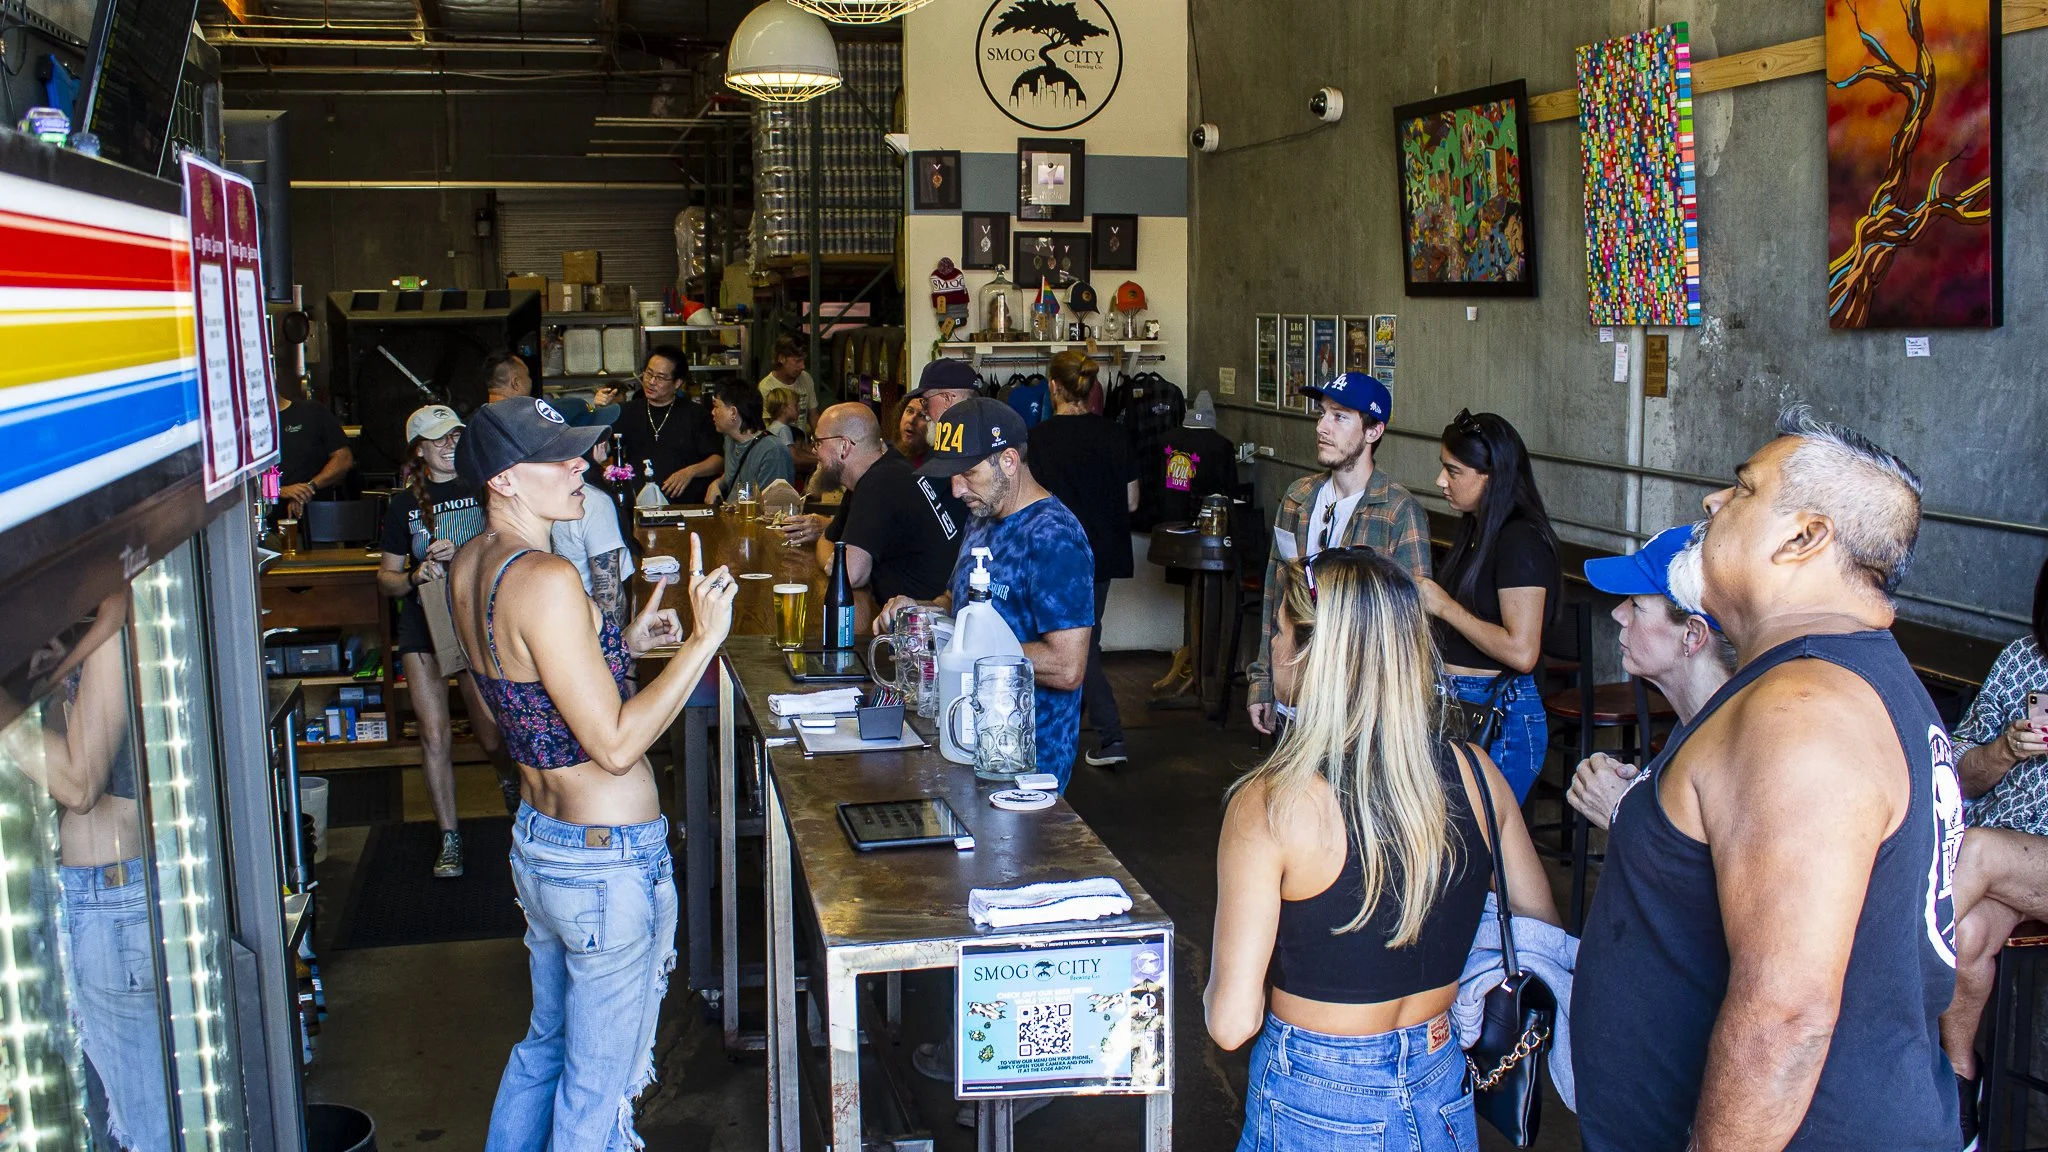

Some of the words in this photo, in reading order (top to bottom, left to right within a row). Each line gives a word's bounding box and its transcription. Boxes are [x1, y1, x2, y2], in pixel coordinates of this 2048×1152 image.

[987, 47, 1035, 62] SMOG
[1064, 50, 1104, 64] CITY
[974, 964, 1029, 982] SMOG
[1058, 958, 1101, 976] CITY
[1070, 973, 1091, 981] Brewing
